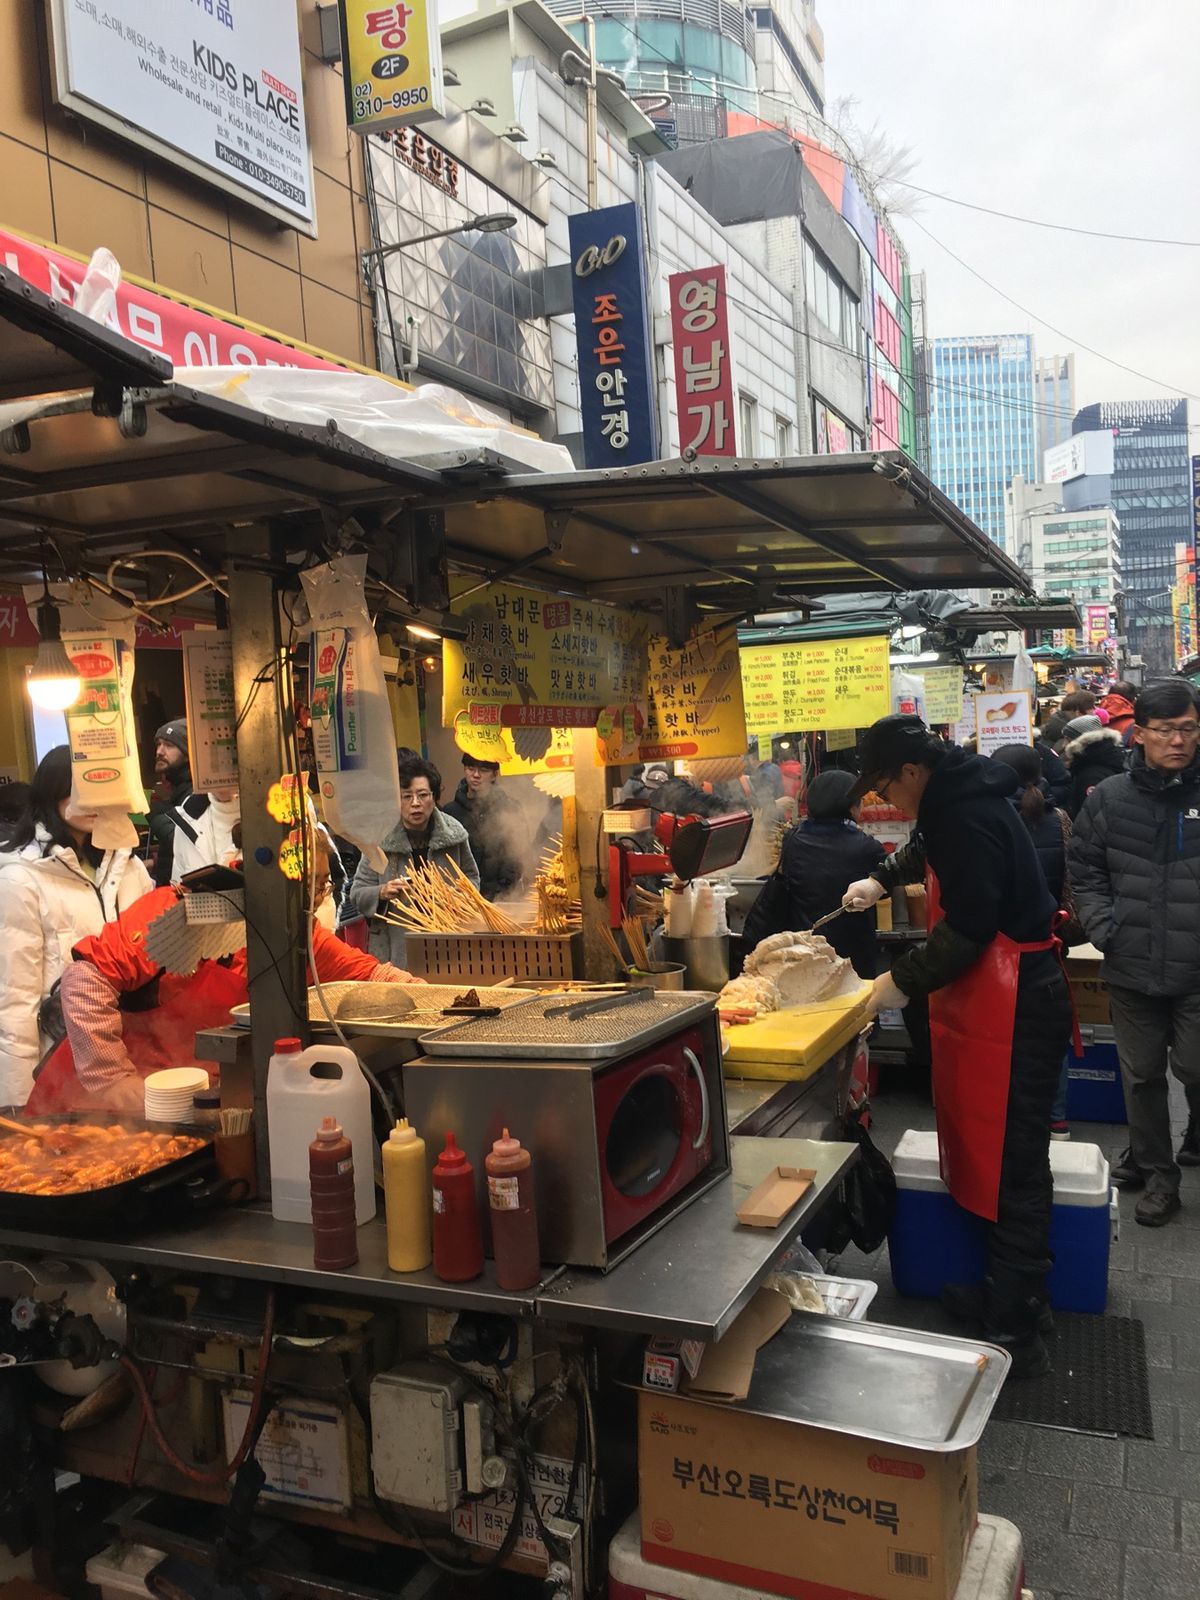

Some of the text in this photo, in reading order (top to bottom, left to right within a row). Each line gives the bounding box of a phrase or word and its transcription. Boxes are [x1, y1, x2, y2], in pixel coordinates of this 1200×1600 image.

[366, 3, 413, 50] 탕
[380, 57, 400, 76] 2F
[193, 39, 300, 132] KIDS PLACE
[355, 83, 372, 97] 02)
[138, 55, 302, 167] Wholesale and retail Kids Multi place store
[356, 86, 428, 118] 310-9950
[679, 278, 729, 450] 영남가
[494, 594, 540, 624] 남대문
[834, 647, 849, 658] 순대
[462, 662, 528, 687] 새우핫바
[551, 670, 597, 691] 맛살핫바
[693, 726, 721, 737] Pepper)
[672, 1456, 900, 1536] 부산오륙도상천어묵
